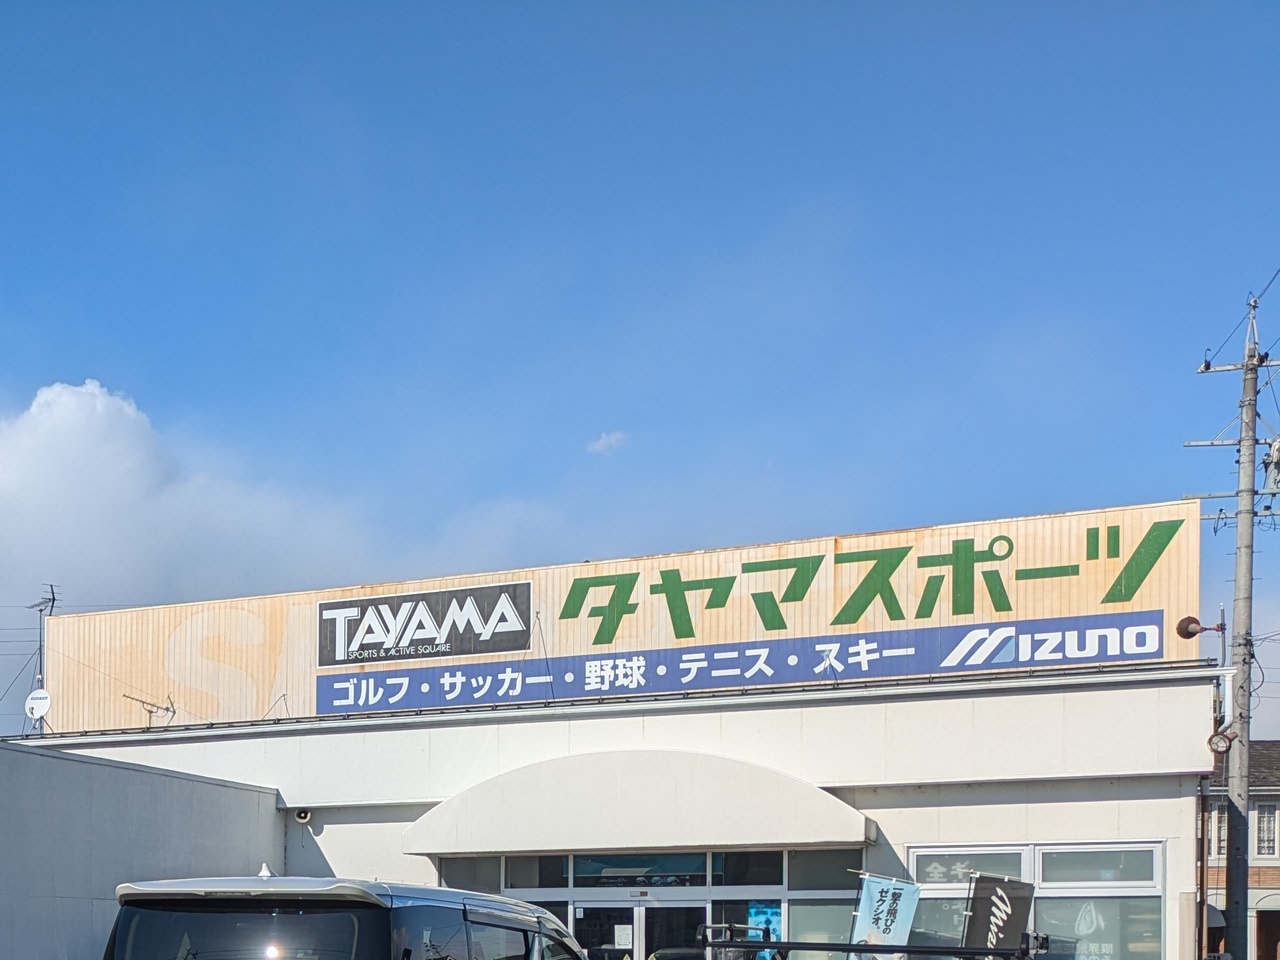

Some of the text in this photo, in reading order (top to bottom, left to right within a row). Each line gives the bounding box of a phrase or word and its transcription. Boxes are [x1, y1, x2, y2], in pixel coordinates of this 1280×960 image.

[559, 518, 1186, 645] タヤマスポーツ
[322, 592, 526, 661] TAYAMA
[348, 642, 451, 660] SPORTS & ACTIVE SQUARE
[881, 887, 905, 935] 一撃の飛びの
